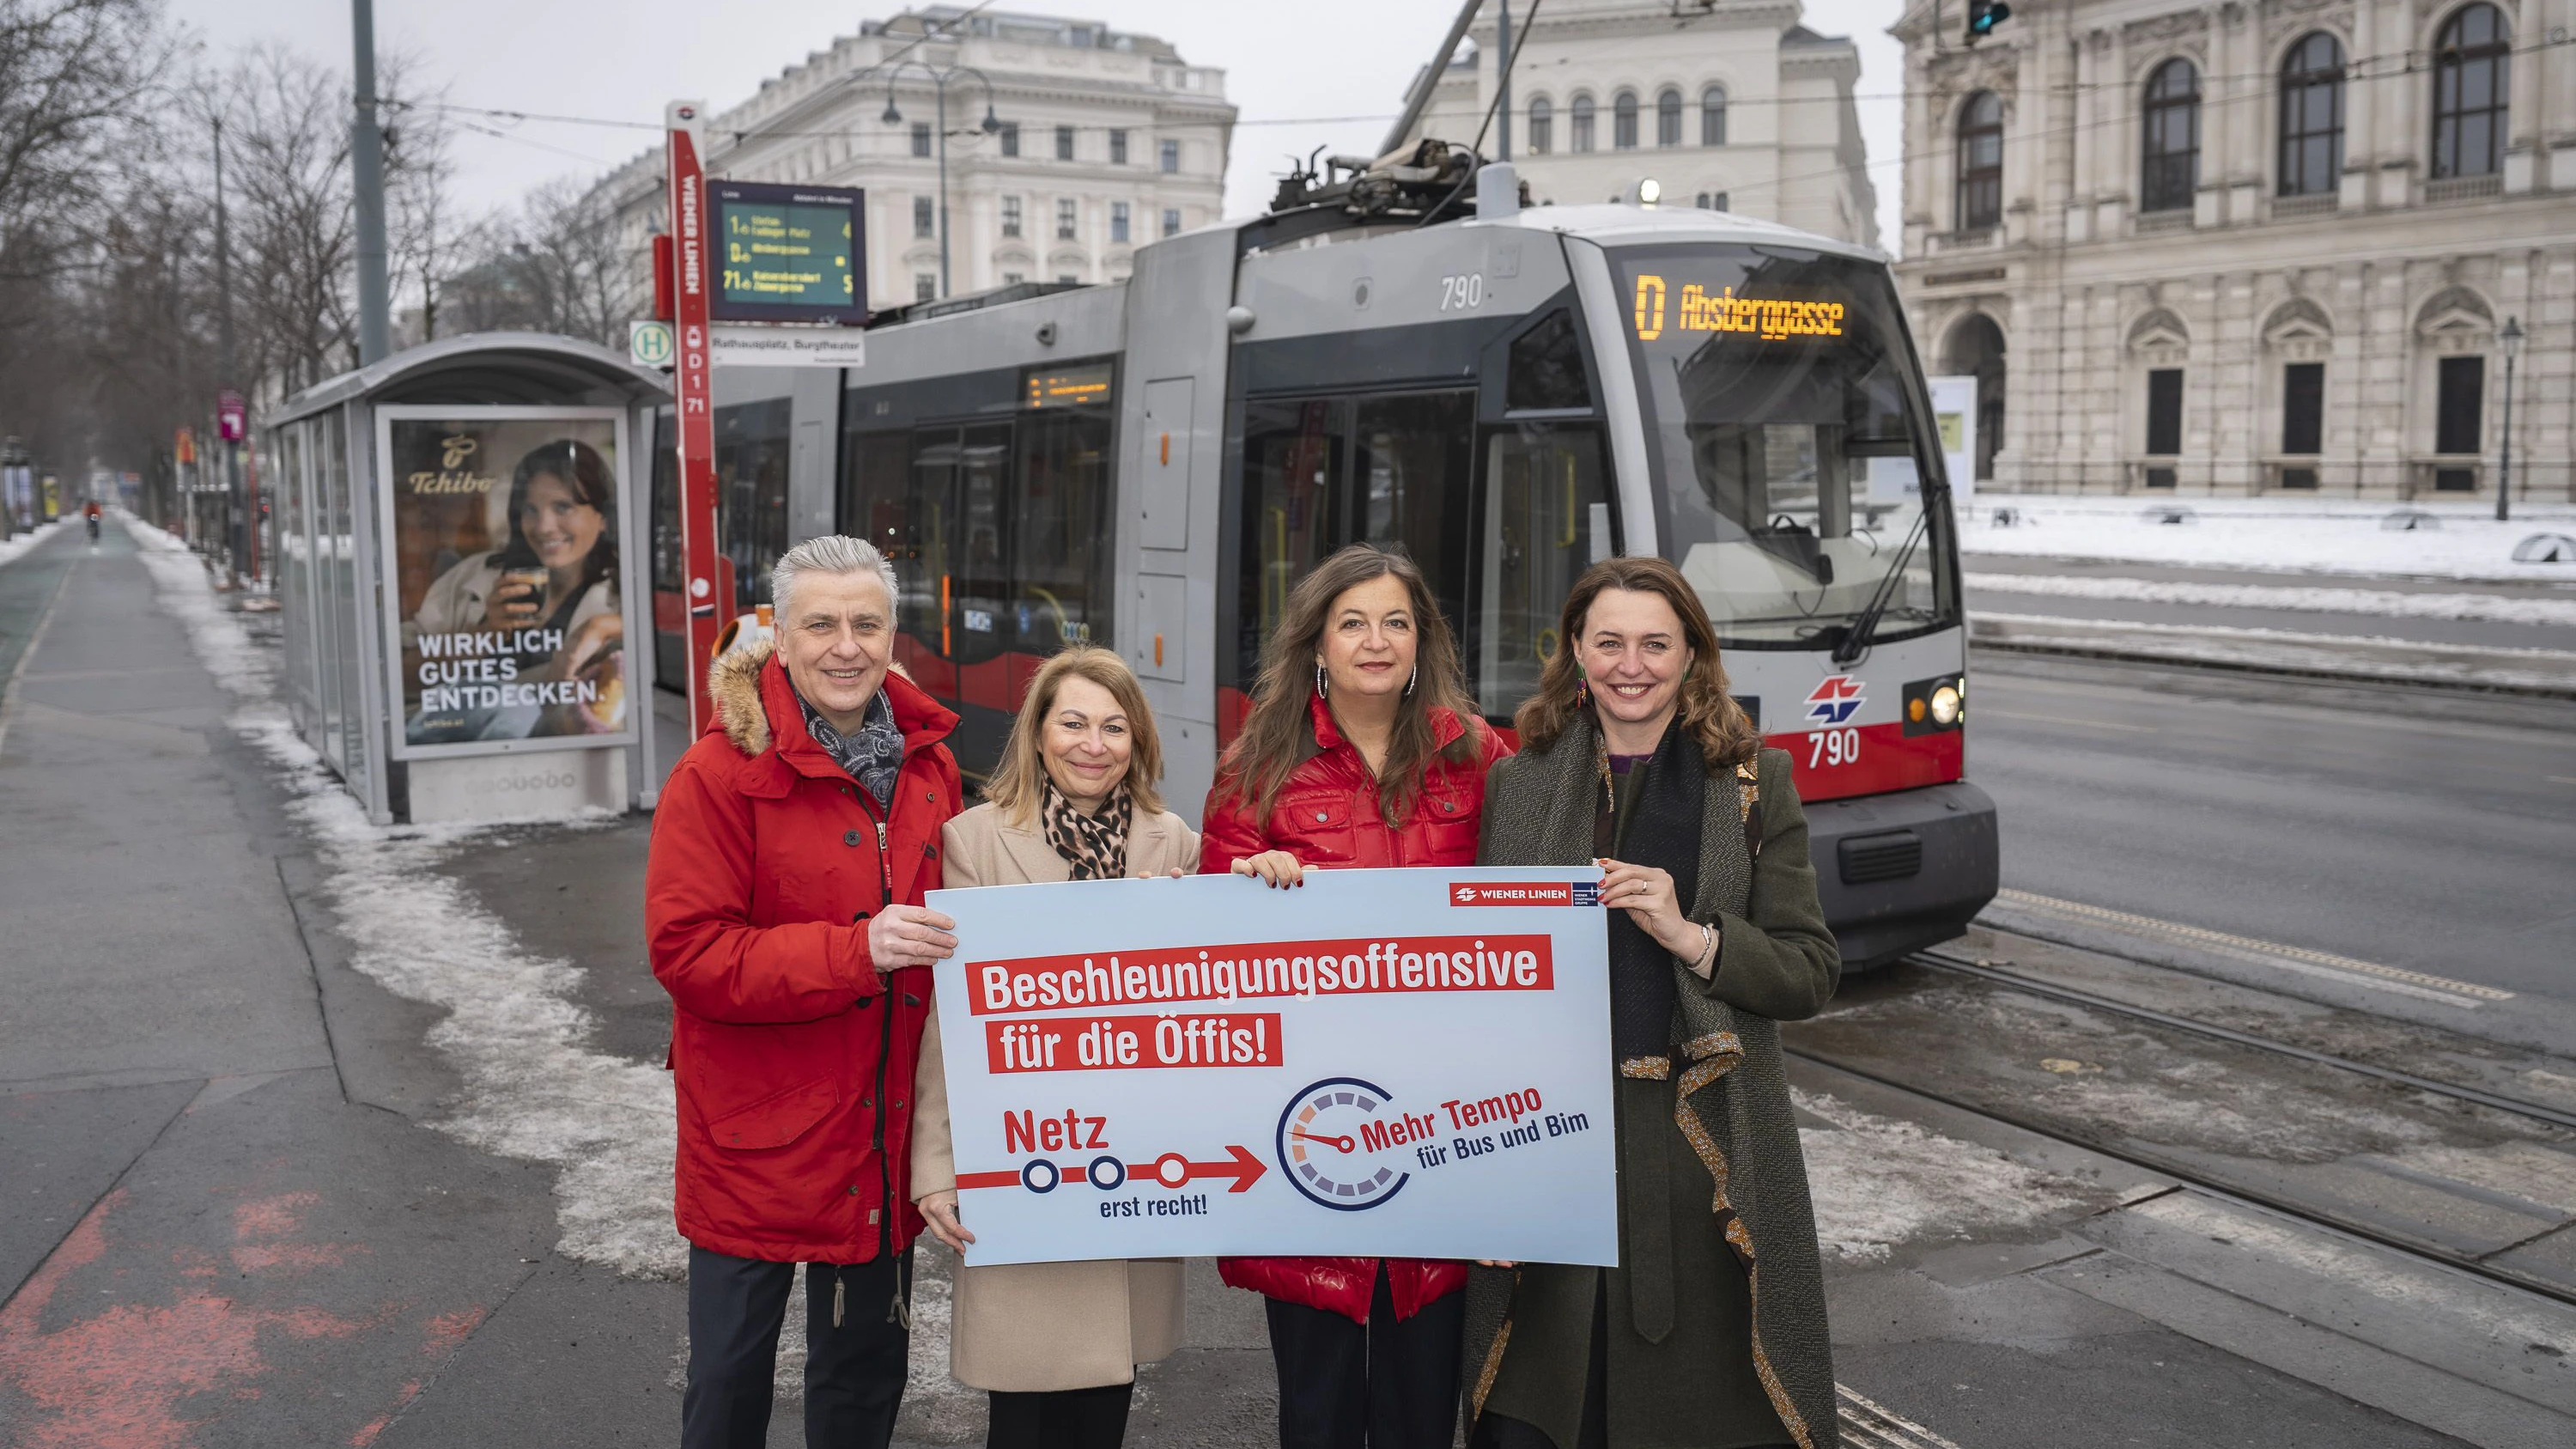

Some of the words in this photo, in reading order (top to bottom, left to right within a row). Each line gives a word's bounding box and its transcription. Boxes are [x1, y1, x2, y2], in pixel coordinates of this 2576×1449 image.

[683, 174, 697, 238] WIENER
[730, 215, 738, 234] 1
[683, 240, 700, 295] LINIEN
[723, 270, 741, 289] 71
[1439, 274, 1483, 312] 790
[1635, 274, 1667, 340] D
[1680, 284, 1844, 340] Absberggasse
[689, 354, 702, 369] D
[691, 374, 700, 388] 1
[686, 398, 704, 413] 71
[408, 471, 496, 495] Tchibo
[418, 628, 563, 659] WIRKLICH
[418, 658, 518, 686] GUTES
[421, 680, 606, 713] ENTDECKEN.
[1808, 728, 1859, 769] 790
[1480, 889, 1526, 899] WIENER
[1528, 889, 1567, 899] LINIEN
[981, 940, 1538, 1010] Beschleunigungsoffensive
[999, 1024, 1061, 1069] für
[1078, 1020, 1139, 1066] die
[1155, 1009, 1267, 1064] Öffis!
[1003, 1108, 1109, 1154] Netz
[1359, 1112, 1436, 1154] Mehr
[1440, 1087, 1543, 1130] Tempo
[1417, 1144, 1447, 1169] für
[1452, 1135, 1495, 1160] Bus
[1499, 1119, 1541, 1149] und
[1544, 1111, 1589, 1138] Bim
[1100, 1196, 1141, 1218] erst
[1147, 1194, 1207, 1216] recht!
